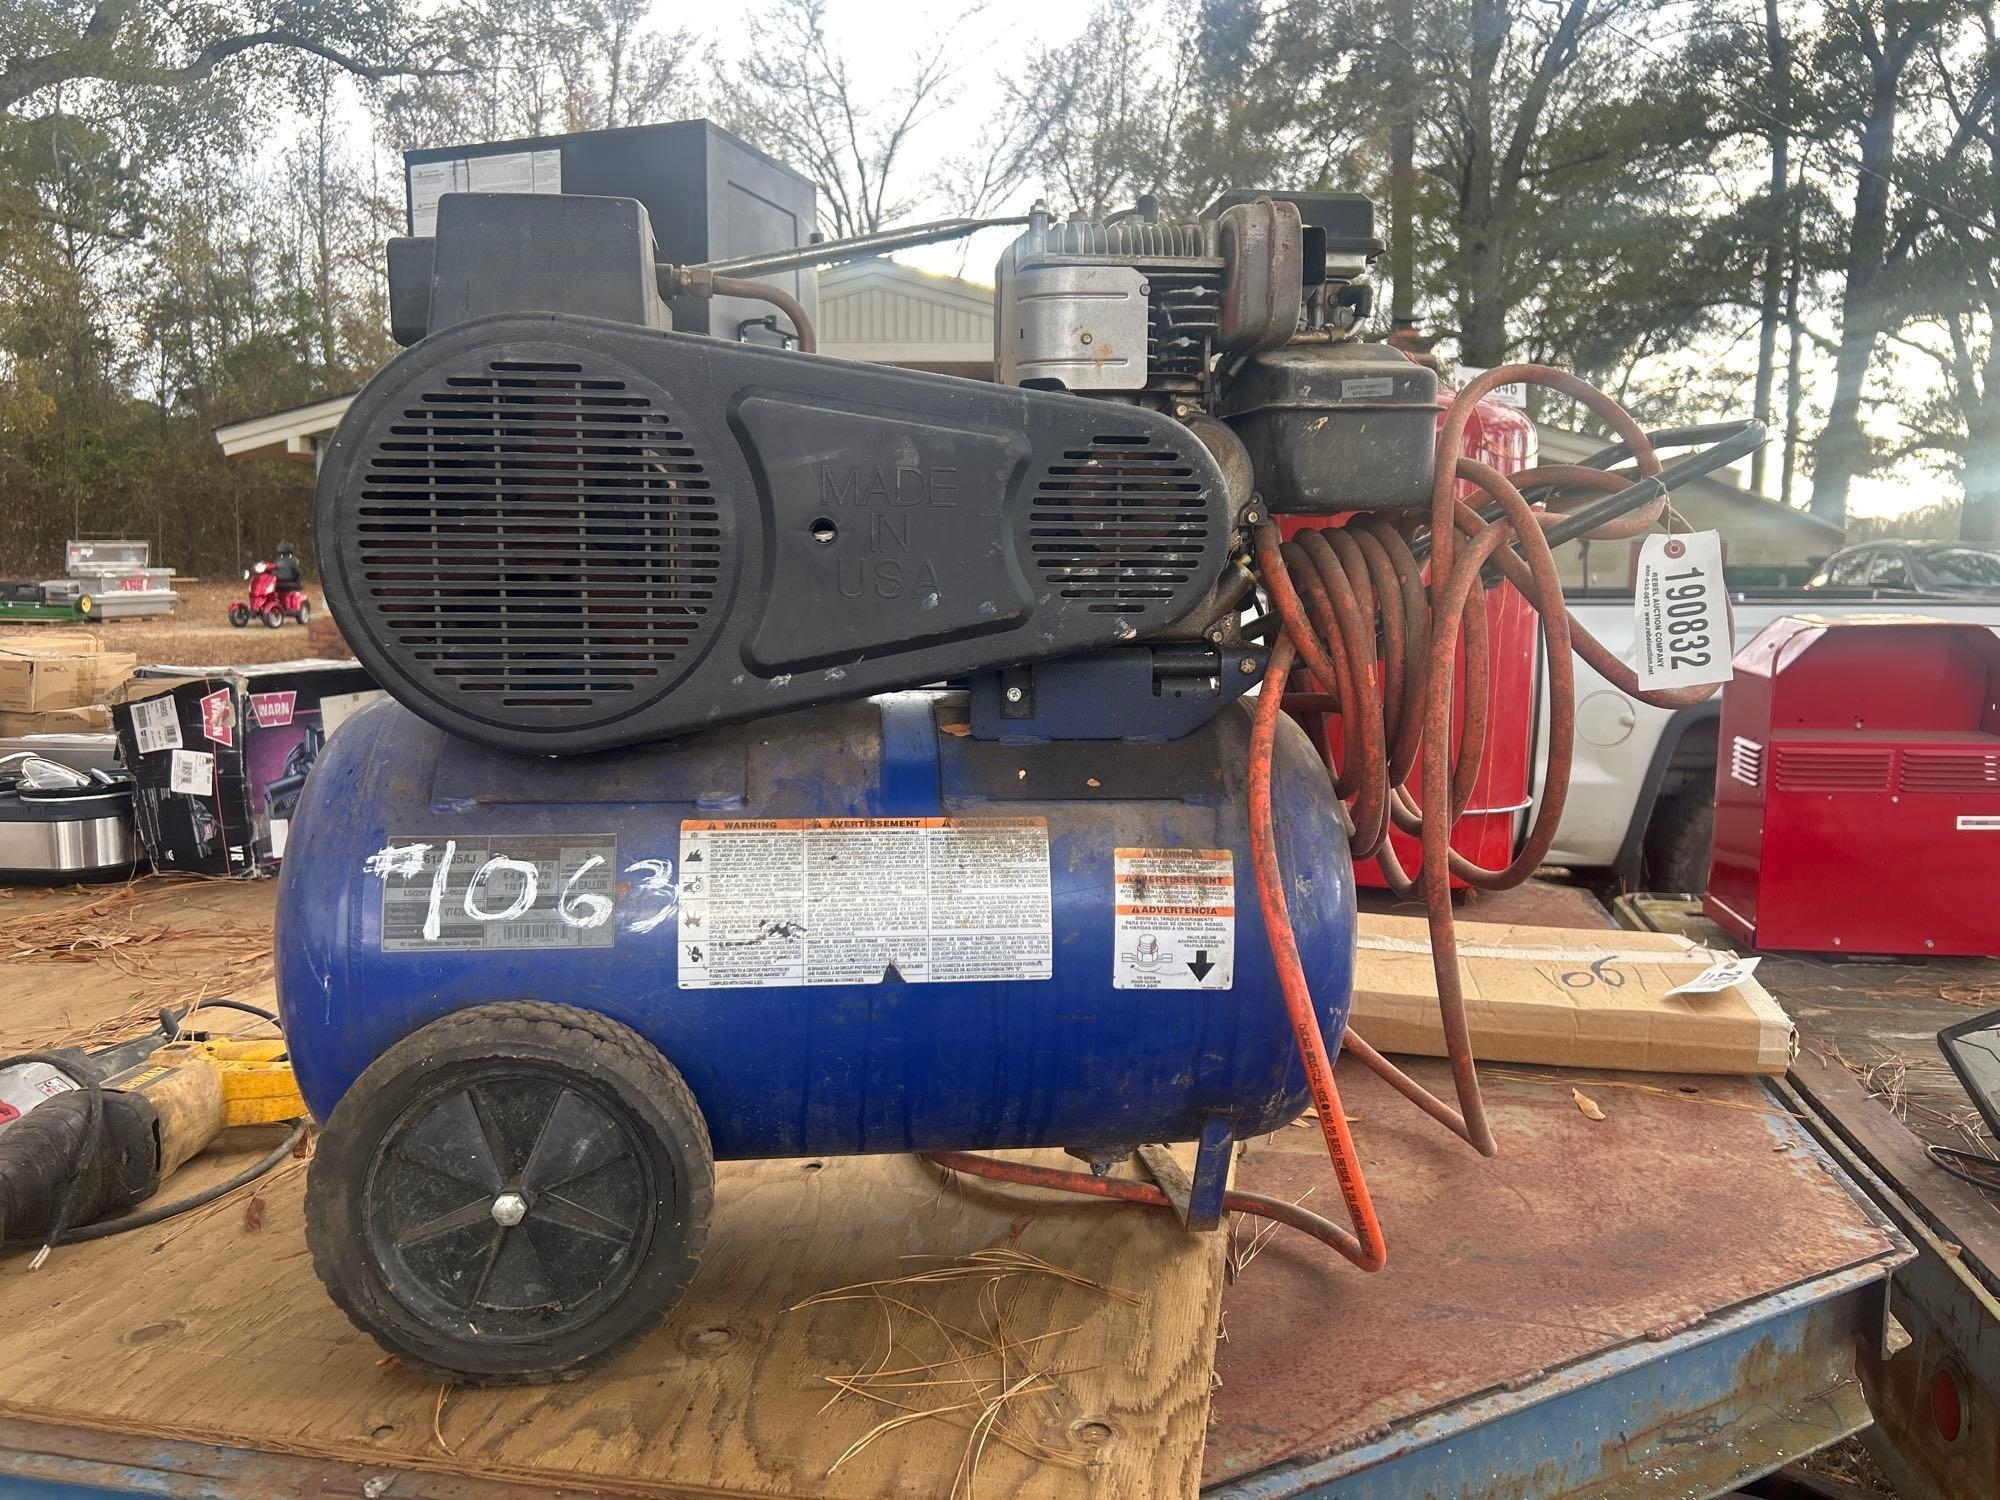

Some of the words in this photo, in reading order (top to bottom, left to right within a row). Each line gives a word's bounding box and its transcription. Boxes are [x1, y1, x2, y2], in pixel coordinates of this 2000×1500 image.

[820, 463, 958, 508] MADE
[871, 512, 911, 554] IN
[838, 557, 941, 600] USA
[1651, 572, 1660, 597] REBEL
[1653, 599, 1662, 631] AUCTION
[1665, 566, 1711, 670] 190832
[1655, 632, 1665, 668] COMPANY
[258, 702, 290, 717] WARN
[724, 821, 778, 829] WARNING
[829, 819, 921, 828] AVERTISSEMENT
[578, 880, 608, 890] GALLON
[1141, 906, 1218, 915] ADVERTENCIA
[1316, 1088, 1329, 1104] HOSE
[1330, 1137, 1344, 1156] BURST
[1336, 1156, 1352, 1184] PRESSURE
